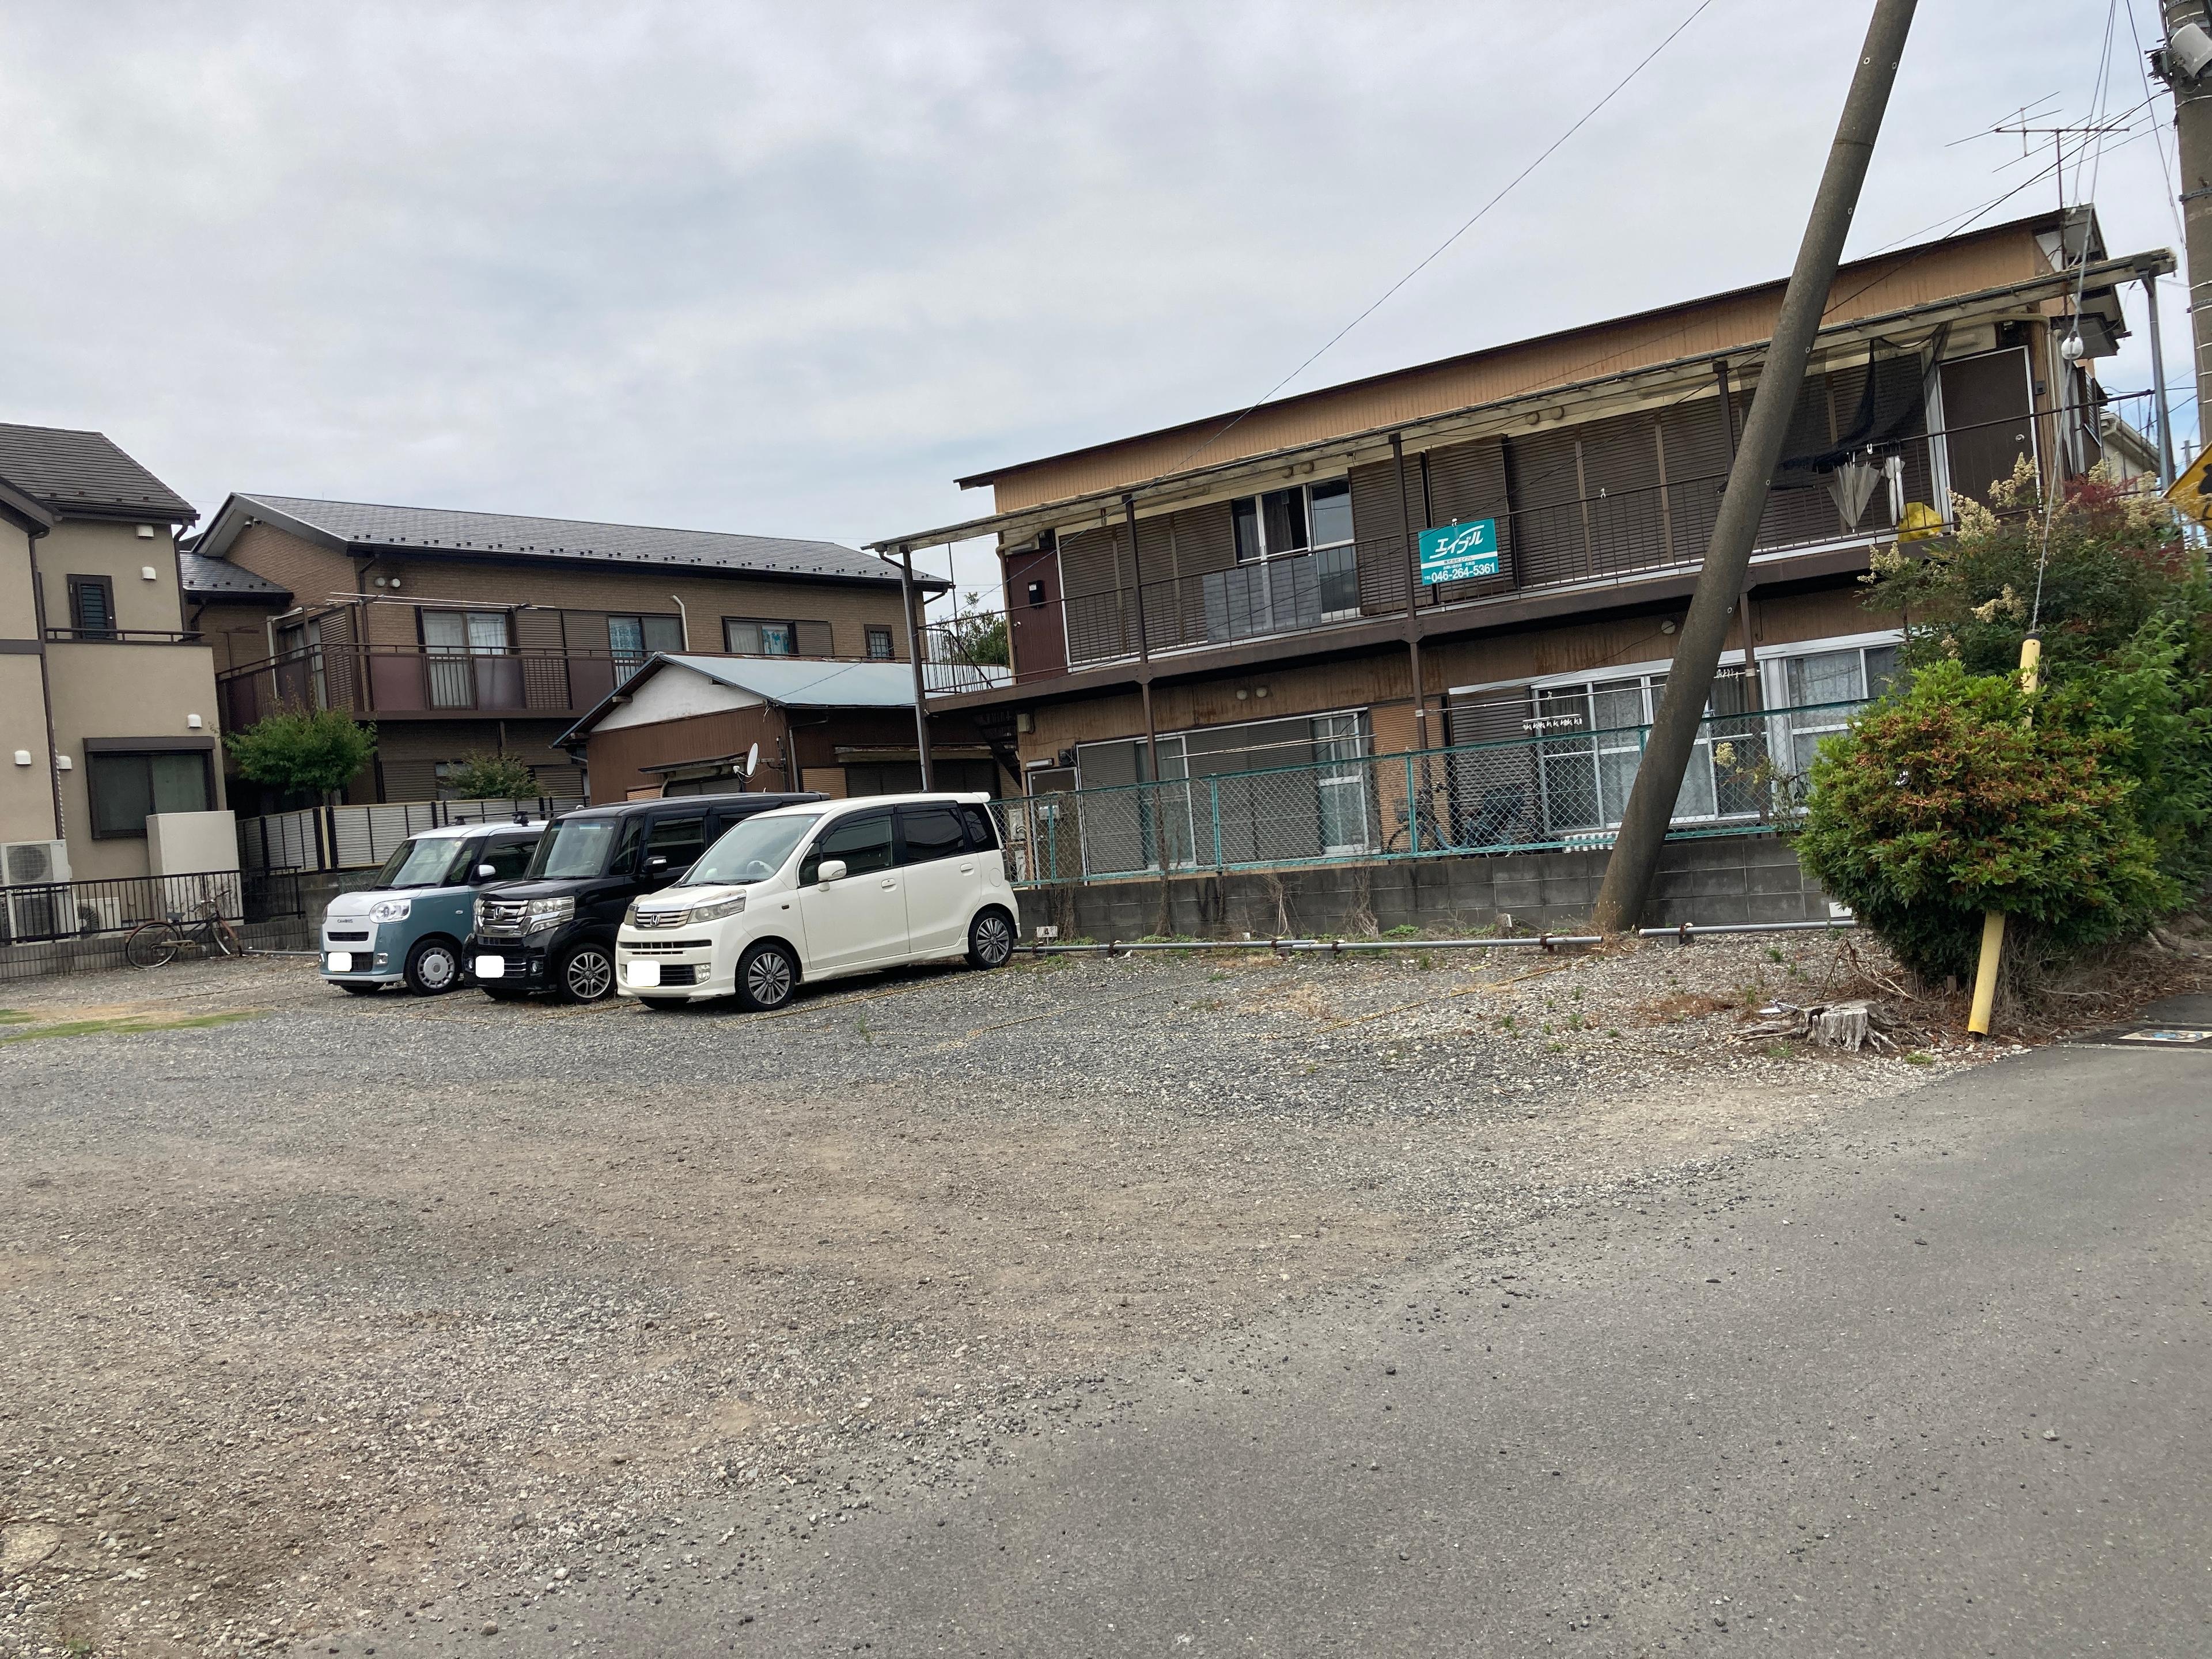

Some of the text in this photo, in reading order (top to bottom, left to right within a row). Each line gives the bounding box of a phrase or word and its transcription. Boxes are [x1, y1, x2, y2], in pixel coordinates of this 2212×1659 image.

[1429, 525, 1484, 559] エイブル
[1431, 562, 1495, 582] 046-264-5361
